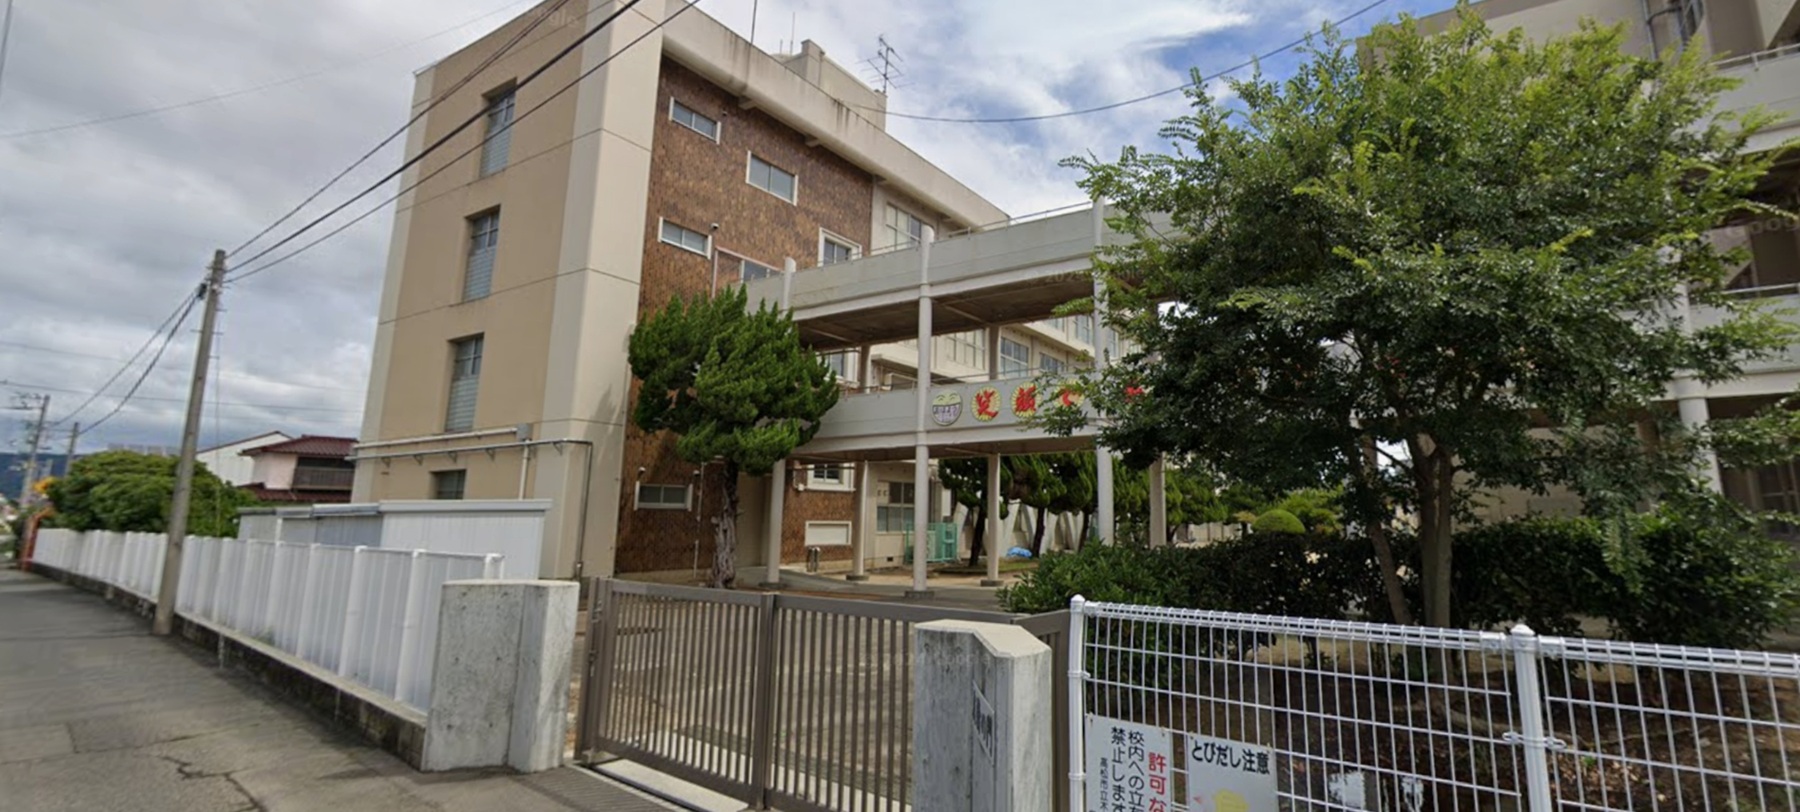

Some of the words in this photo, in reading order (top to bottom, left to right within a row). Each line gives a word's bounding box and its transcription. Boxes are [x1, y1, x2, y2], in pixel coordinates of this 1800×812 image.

[1191, 739, 1270, 775] とびだし注意
[1148, 751, 1167, 812] 許可な
